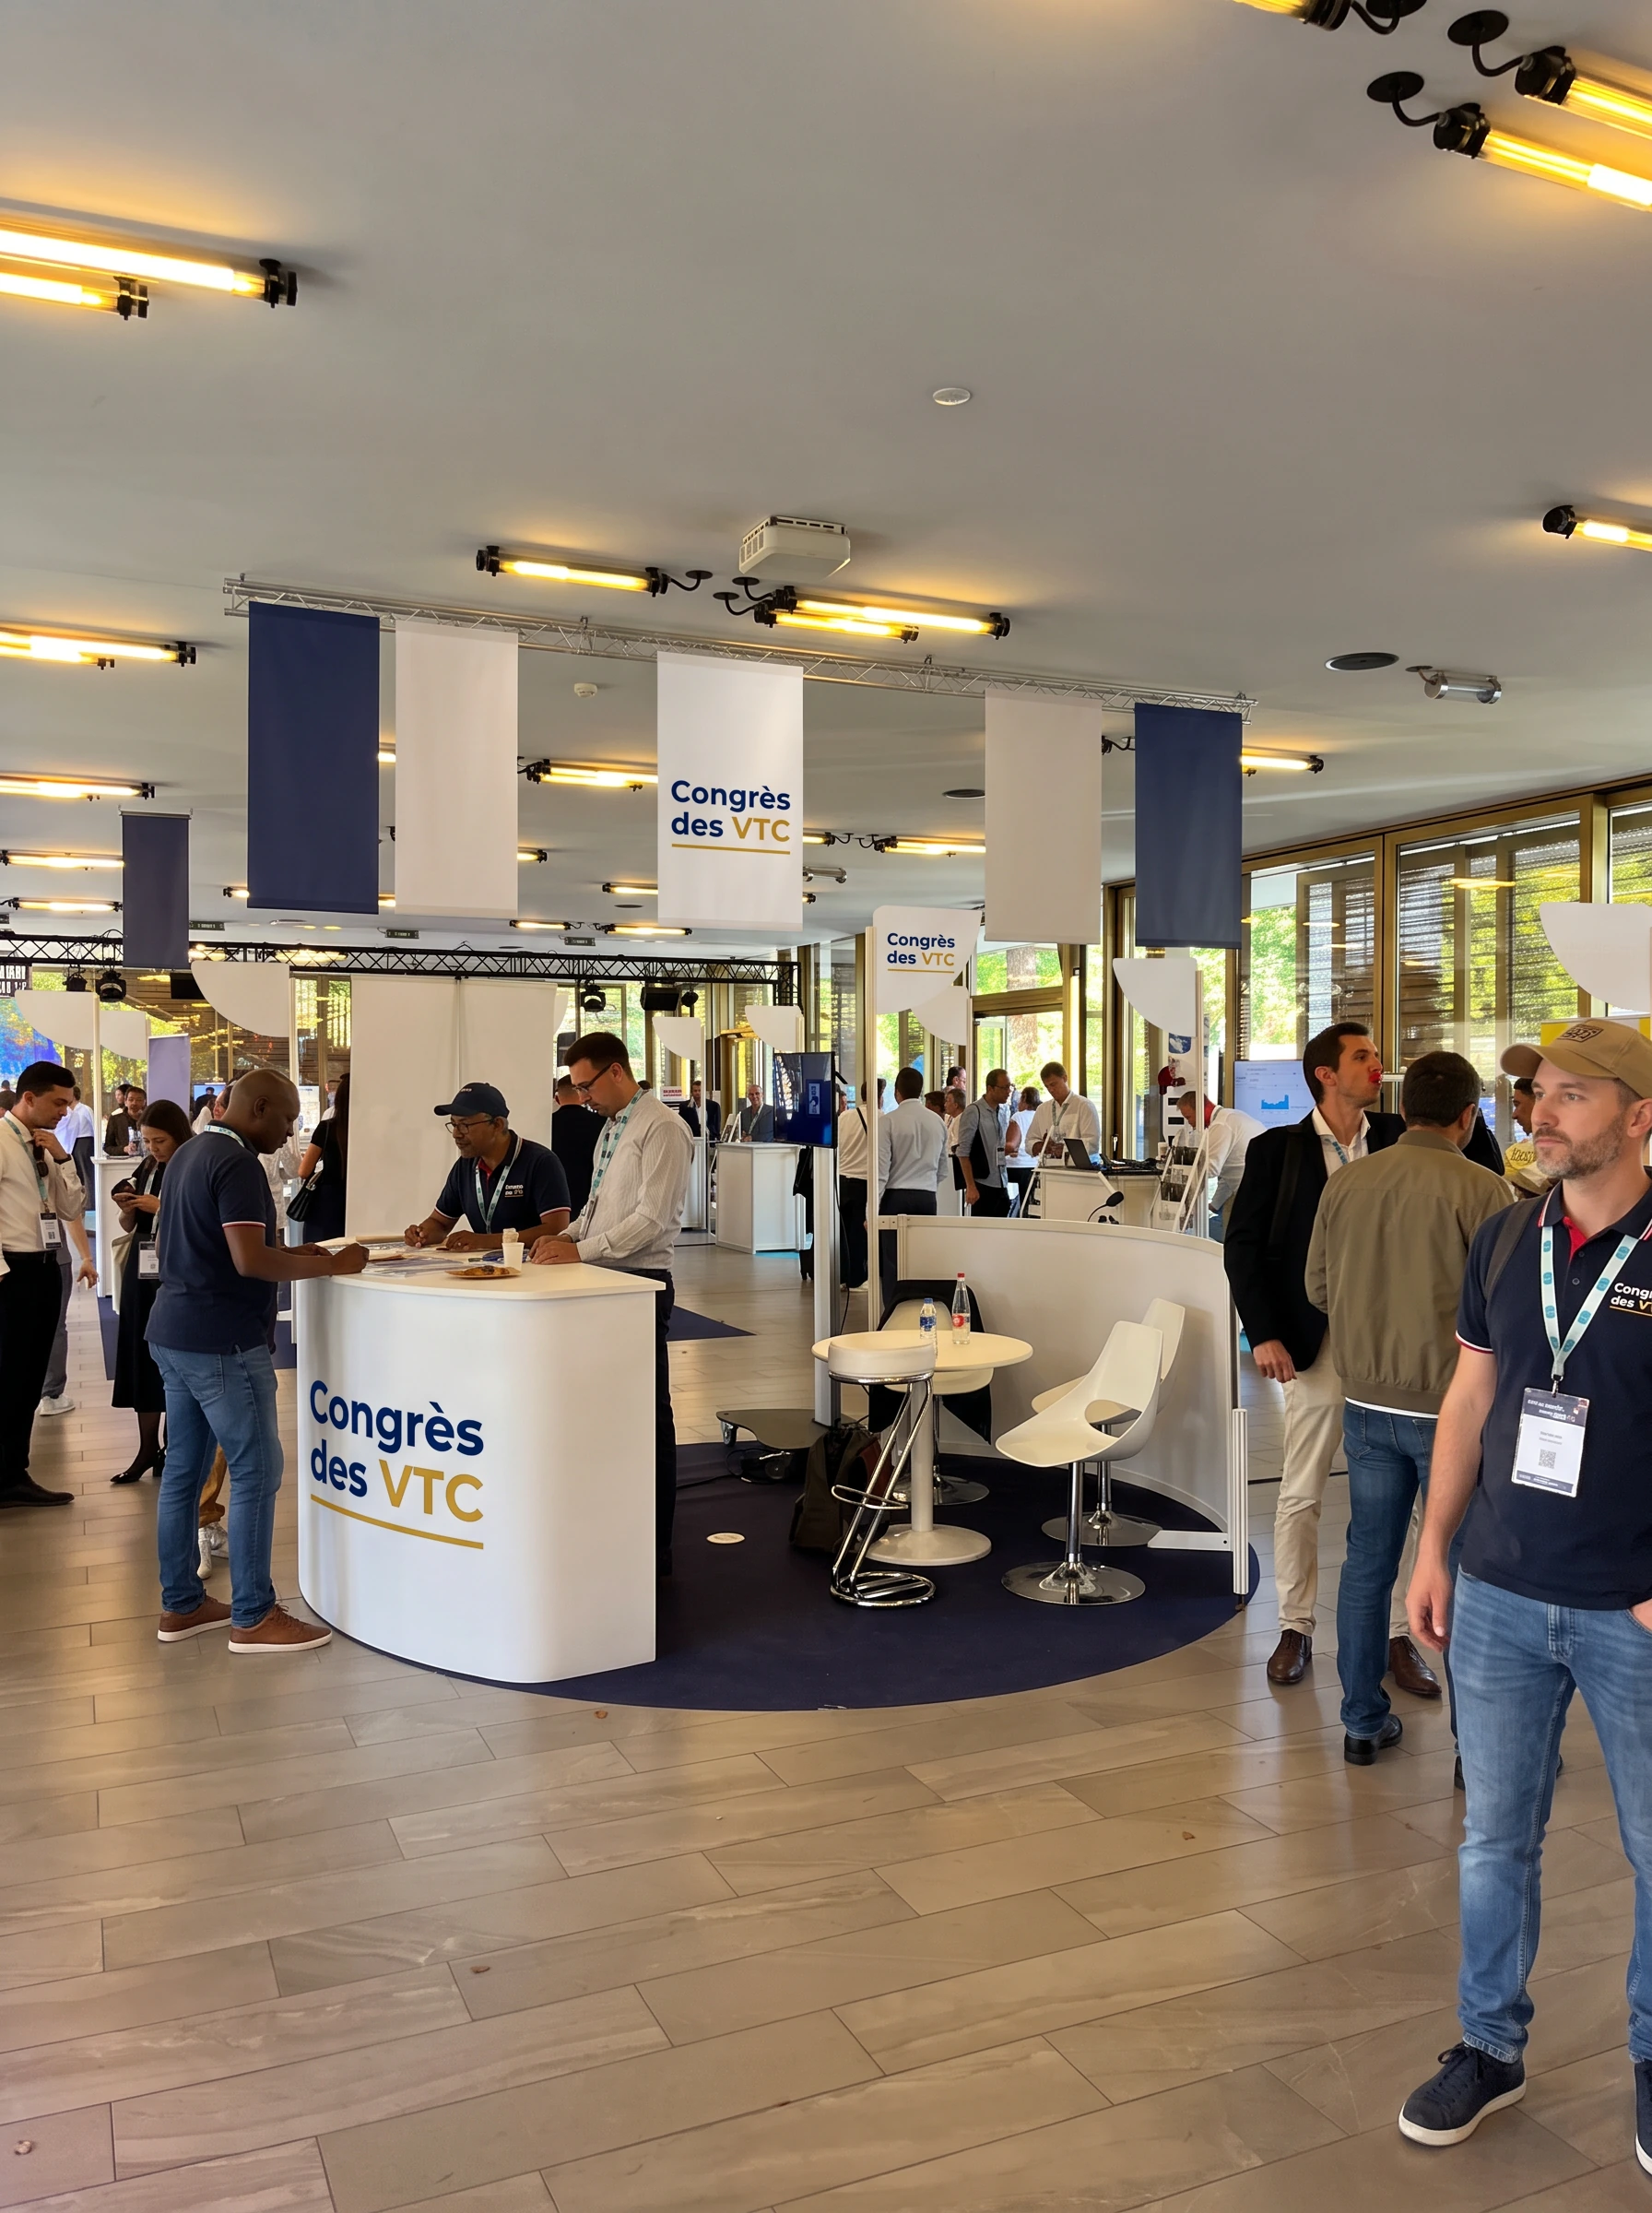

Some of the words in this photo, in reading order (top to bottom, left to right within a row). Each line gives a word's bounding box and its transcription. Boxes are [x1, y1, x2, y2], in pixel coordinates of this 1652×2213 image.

[670, 779, 791, 813] Congrès
[670, 811, 724, 838] des
[732, 816, 790, 843] VTC
[887, 932, 956, 951] Congrès
[887, 950, 917, 964] des
[922, 952, 955, 967] VTC
[1610, 1295, 1635, 1308] des
[310, 1379, 484, 1457] Congrès
[310, 1438, 369, 1498] des
[378, 1458, 484, 1523] VTC
